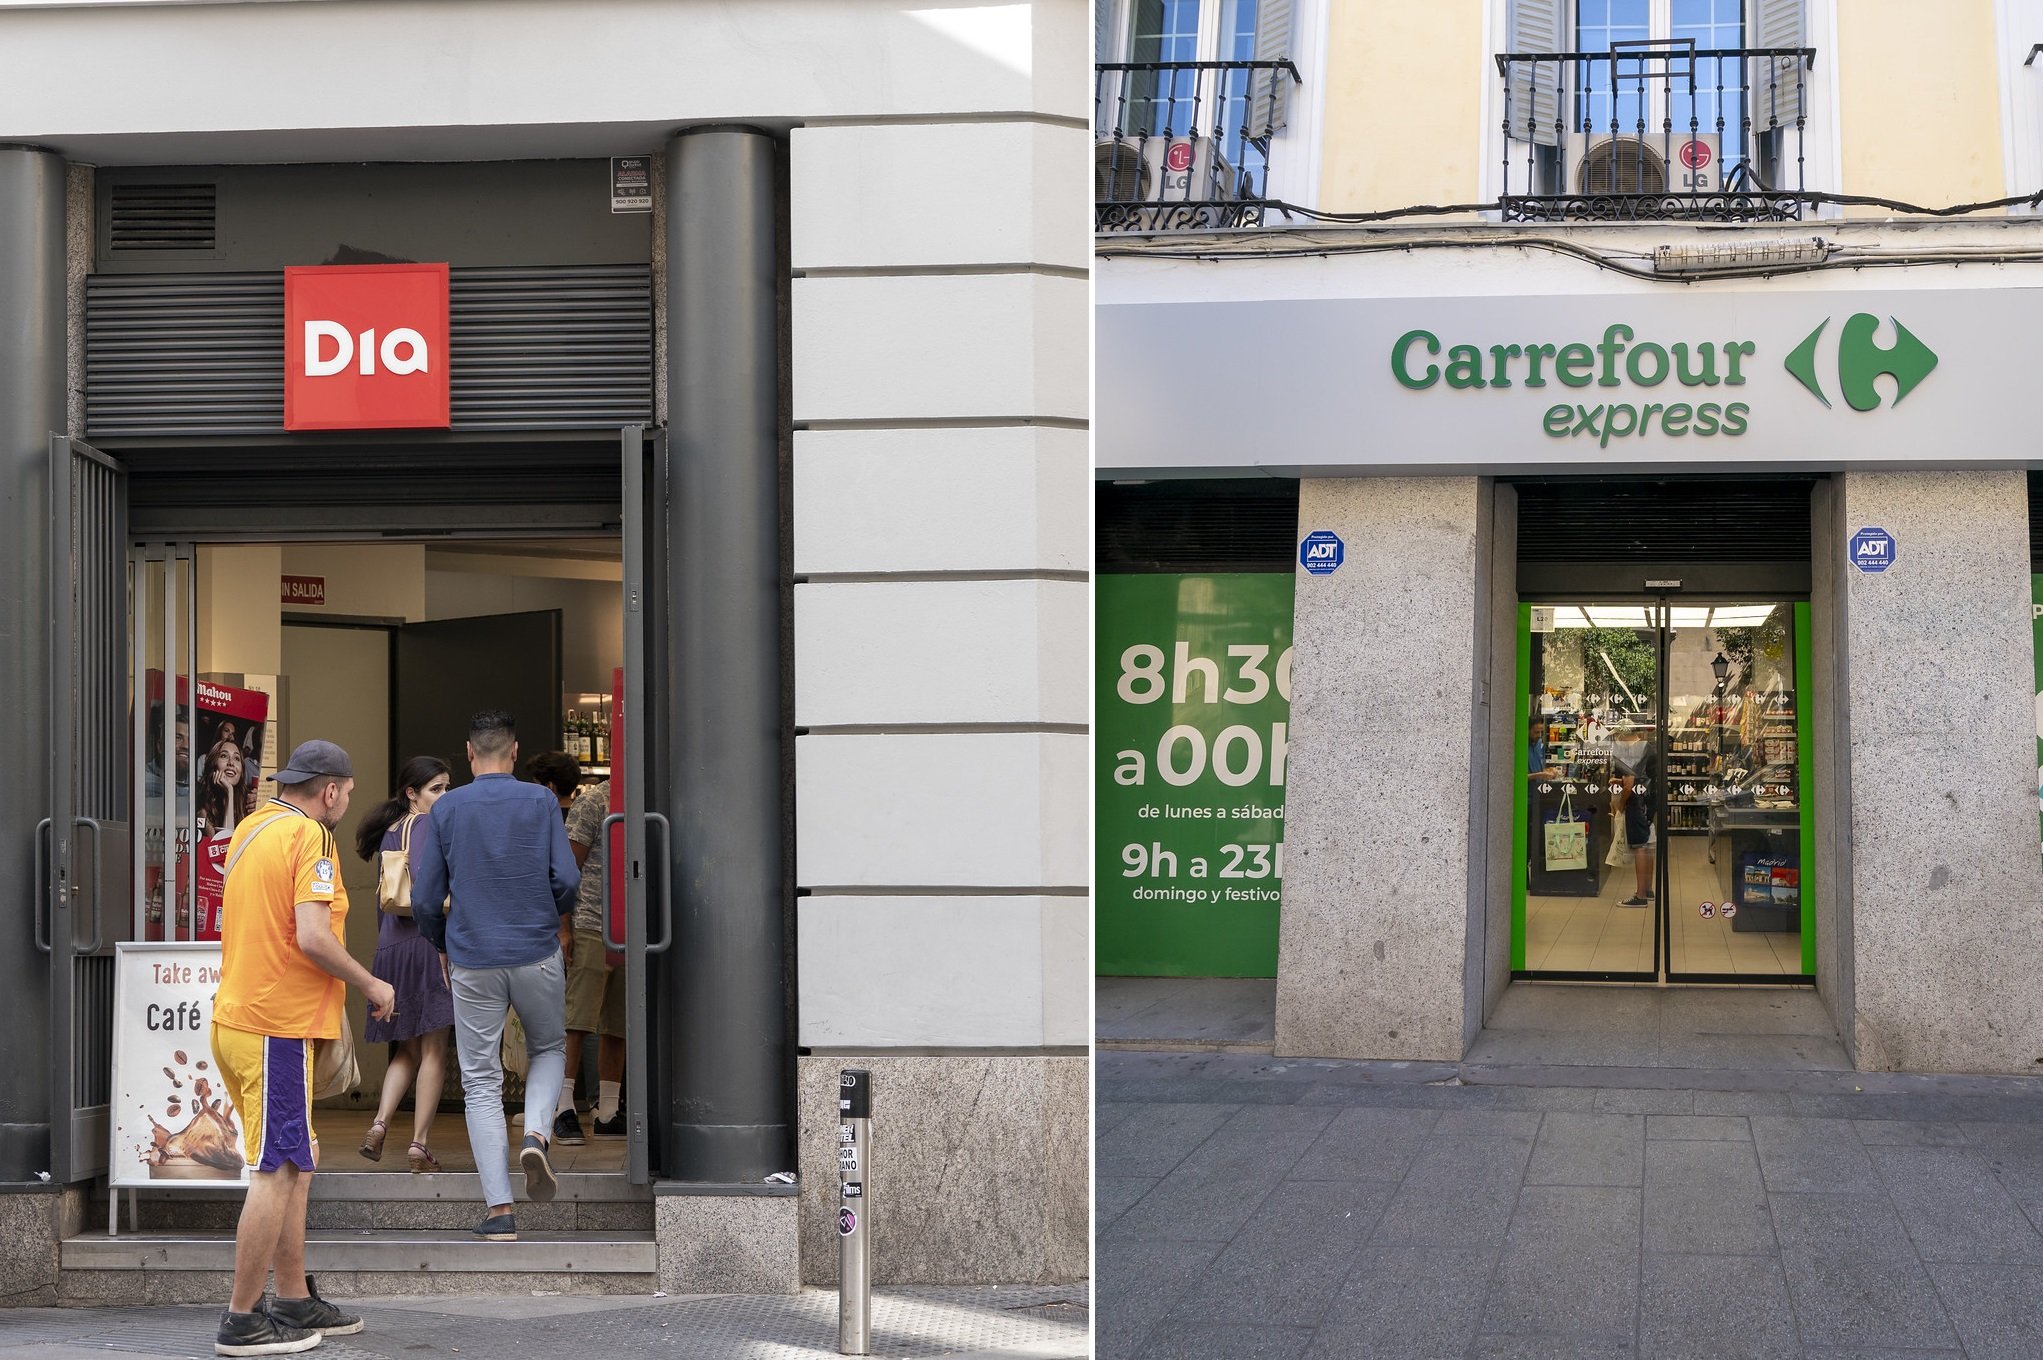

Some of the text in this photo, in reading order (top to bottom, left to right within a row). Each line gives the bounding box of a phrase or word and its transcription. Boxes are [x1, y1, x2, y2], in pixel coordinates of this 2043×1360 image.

[1165, 175, 1187, 190] LG
[1683, 174, 1708, 188] LG
[1390, 323, 1756, 390] Carrefour
[1542, 402, 1750, 449] express
[1307, 544, 1337, 558] ADT
[1857, 540, 1888, 556] ADT
[292, 582, 324, 598] SALIDA
[197, 683, 232, 702] Mahou
[1114, 750, 1145, 785] a
[1577, 757, 1607, 765] express
[1138, 804, 1160, 818] de
[1165, 804, 1212, 818] lunes
[1217, 807, 1226, 818] a
[1122, 842, 1178, 878] 9h
[1189, 857, 1208, 878] a
[1132, 886, 1208, 903] domingo
[1210, 890, 1222, 904] y
[153, 963, 191, 984] Take
[147, 1001, 201, 1031] Café
